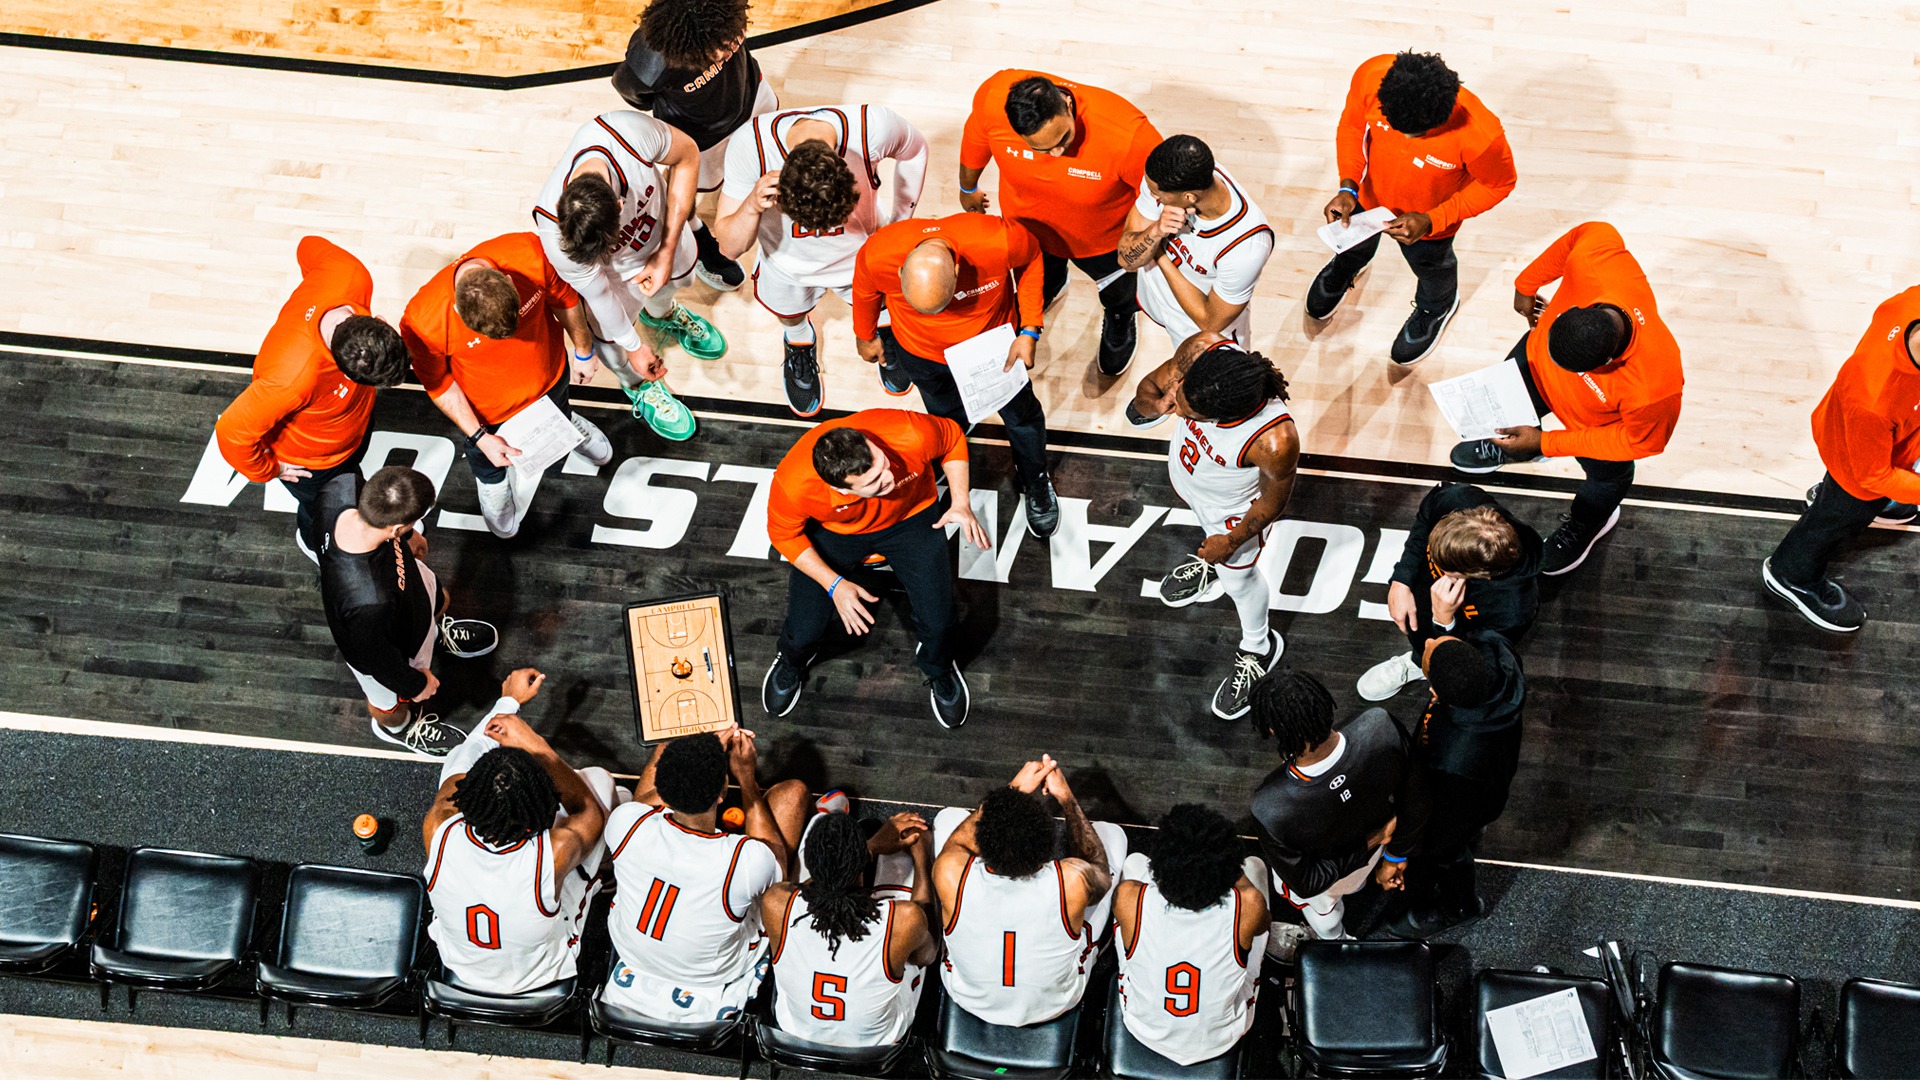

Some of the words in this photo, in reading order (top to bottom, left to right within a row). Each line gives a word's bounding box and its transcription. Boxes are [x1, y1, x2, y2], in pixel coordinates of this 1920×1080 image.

[1067, 166, 1101, 178] CAMPBELL
[518, 289, 543, 315] CAMPBELL
[966, 279, 1000, 296] CAMPBELL
[1179, 436, 1201, 476] 2
[651, 602, 697, 615] CAMPBELL
[1339, 788, 1352, 803] 12
[636, 876, 681, 941] 11
[1002, 931, 1016, 988] 1
[810, 971, 848, 1022] 5
[1164, 960, 1202, 1018] 9
